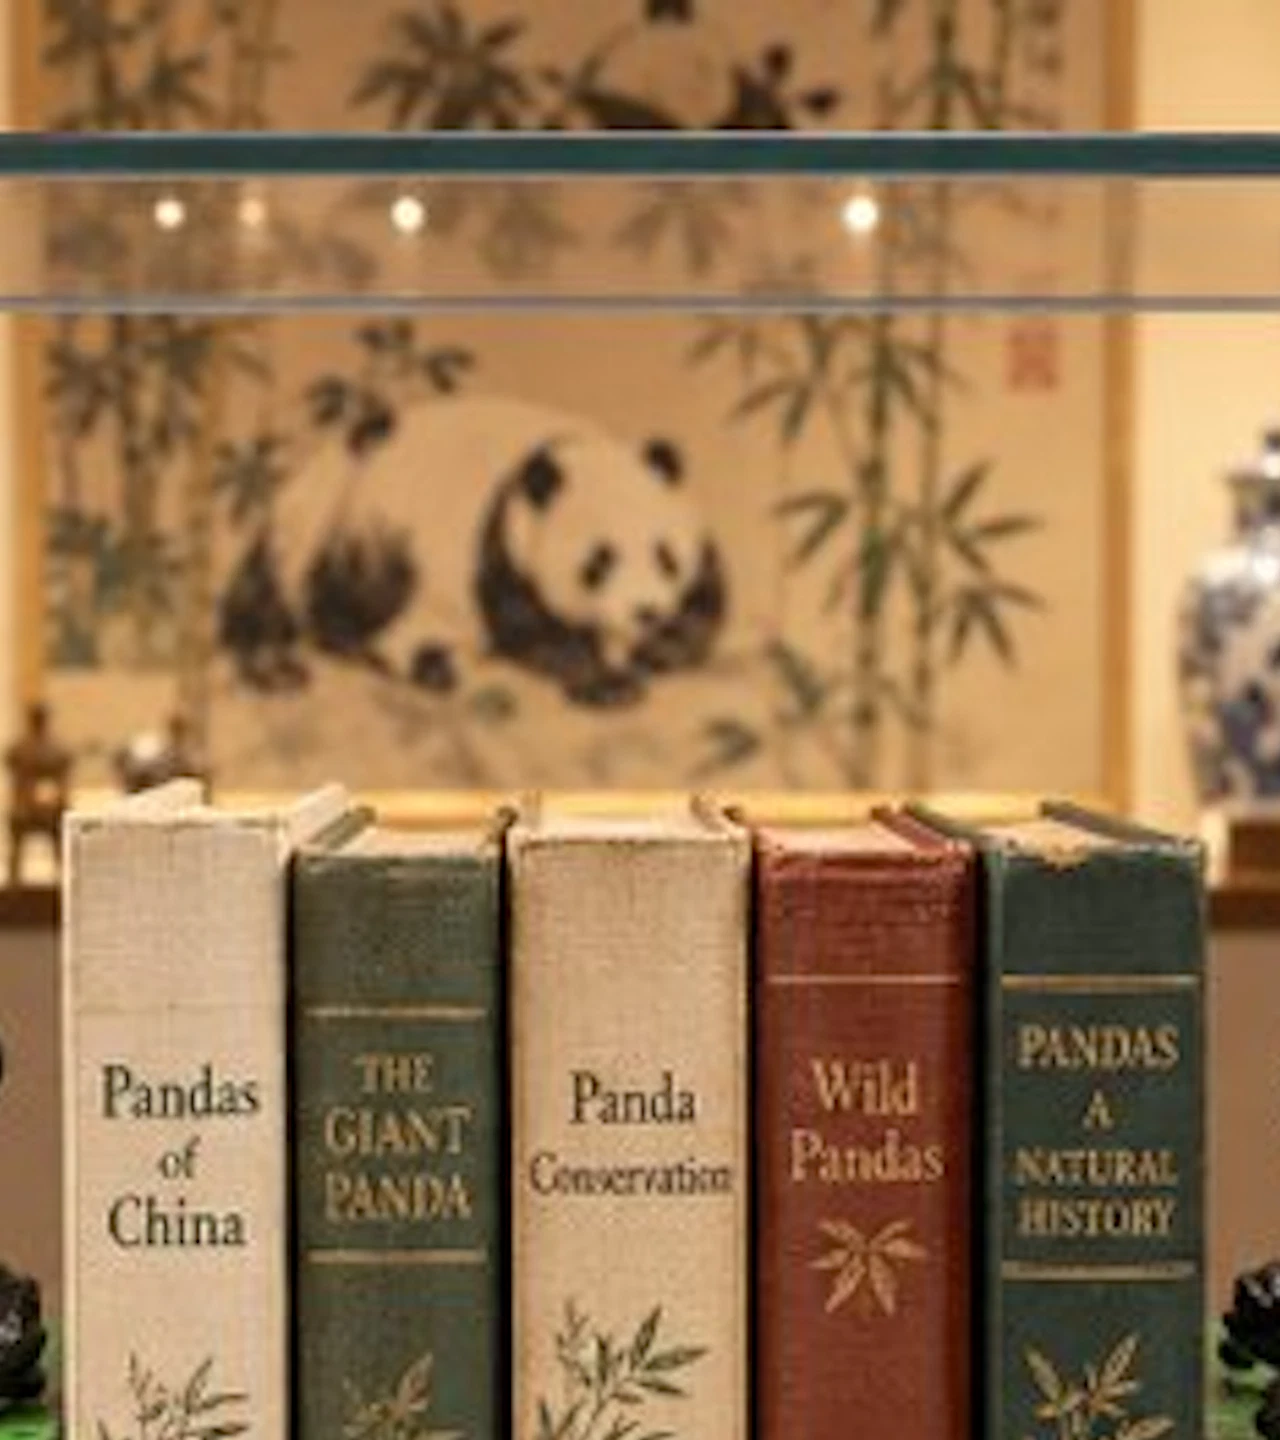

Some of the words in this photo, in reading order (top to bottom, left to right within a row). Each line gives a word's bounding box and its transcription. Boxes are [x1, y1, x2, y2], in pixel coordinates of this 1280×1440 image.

[1017, 1024, 1180, 1068] PANDAS
[102, 1062, 260, 1120] Pandas
[354, 1052, 434, 1094] THE
[810, 1057, 920, 1117] Wild
[569, 1070, 697, 1126] Panda
[1082, 1089, 1114, 1130] A
[323, 1105, 474, 1156] GIANT
[158, 1136, 201, 1180] of
[529, 1153, 734, 1197] Conservation
[790, 1127, 945, 1183] Pandas
[1017, 1147, 1179, 1187] NATURAL
[107, 1193, 246, 1248] China
[322, 1173, 473, 1224] PANDA
[1019, 1196, 1177, 1238] HISTORY
